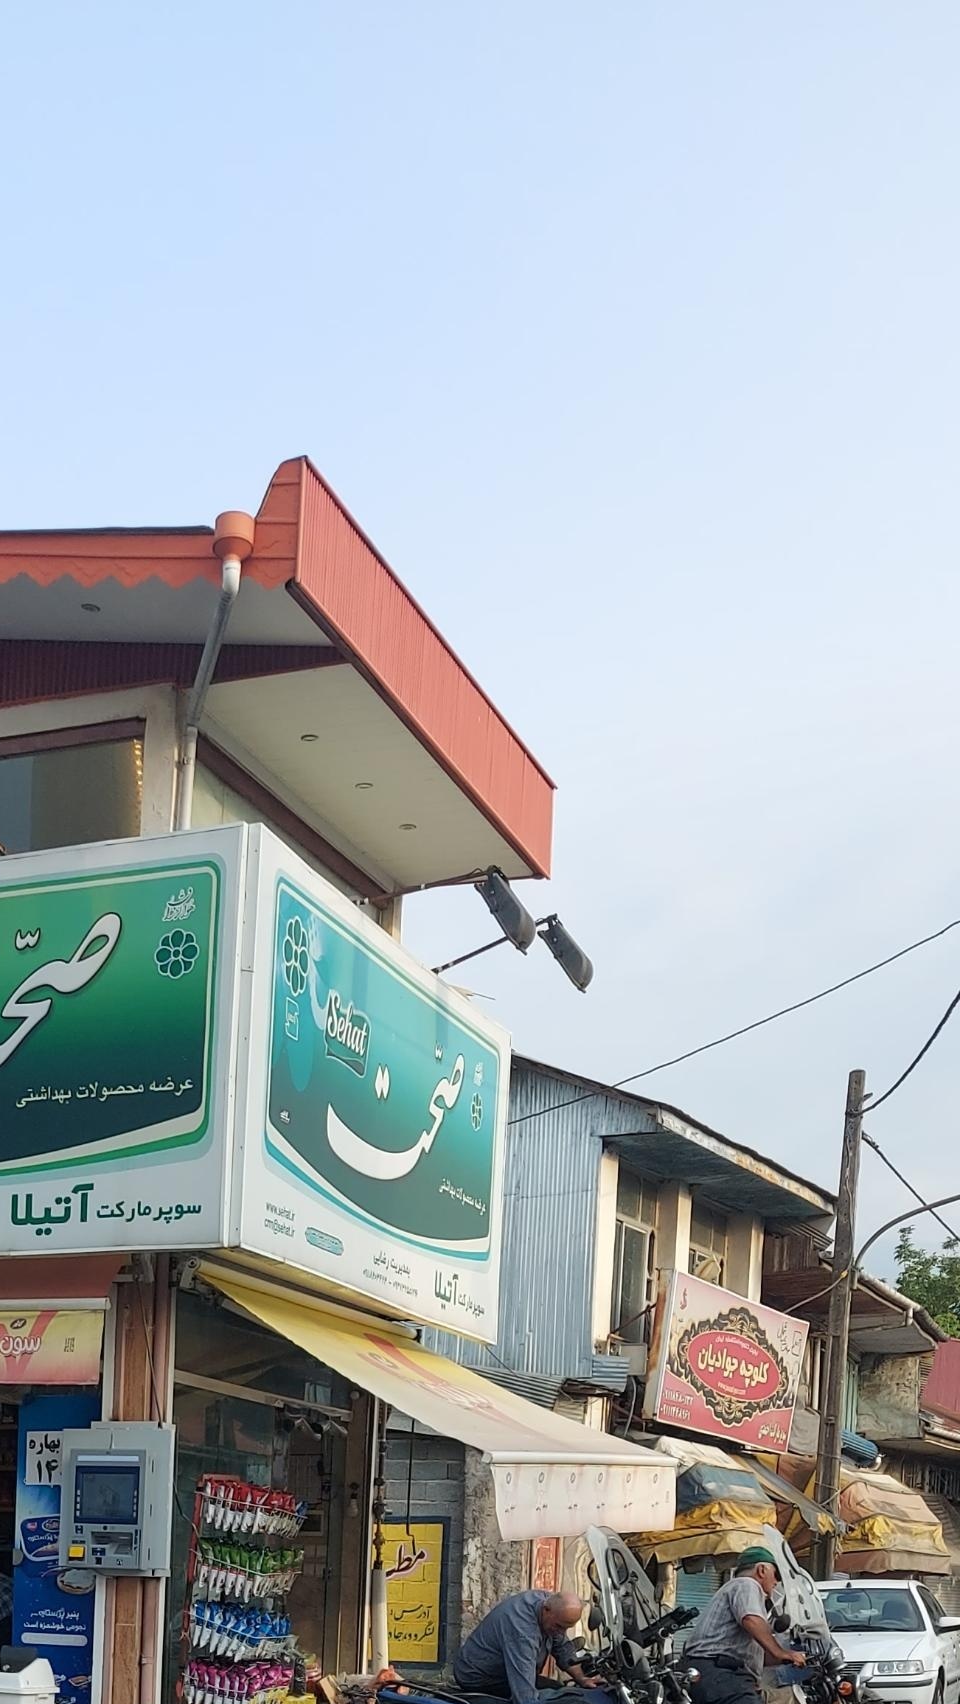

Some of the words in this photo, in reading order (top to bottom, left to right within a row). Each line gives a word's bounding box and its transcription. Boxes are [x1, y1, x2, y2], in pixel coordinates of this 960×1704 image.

[326, 993, 368, 1058] Sehat
[15, 1086, 72, 1108] بهداشتی
[75, 1081, 145, 1102] محصولات
[149, 1075, 194, 1097] عرضه
[10, 1183, 95, 1237] آتیلا
[96, 1200, 152, 1223] مارکت
[152, 1202, 202, 1224] سوپر
[697, 1343, 739, 1378] جوادیان
[739, 1360, 770, 1387] کلوچه
[28, 1433, 61, 1454] بهاره
[36, 1458, 62, 1484] ۱۴
[386, 1542, 428, 1578] مط
